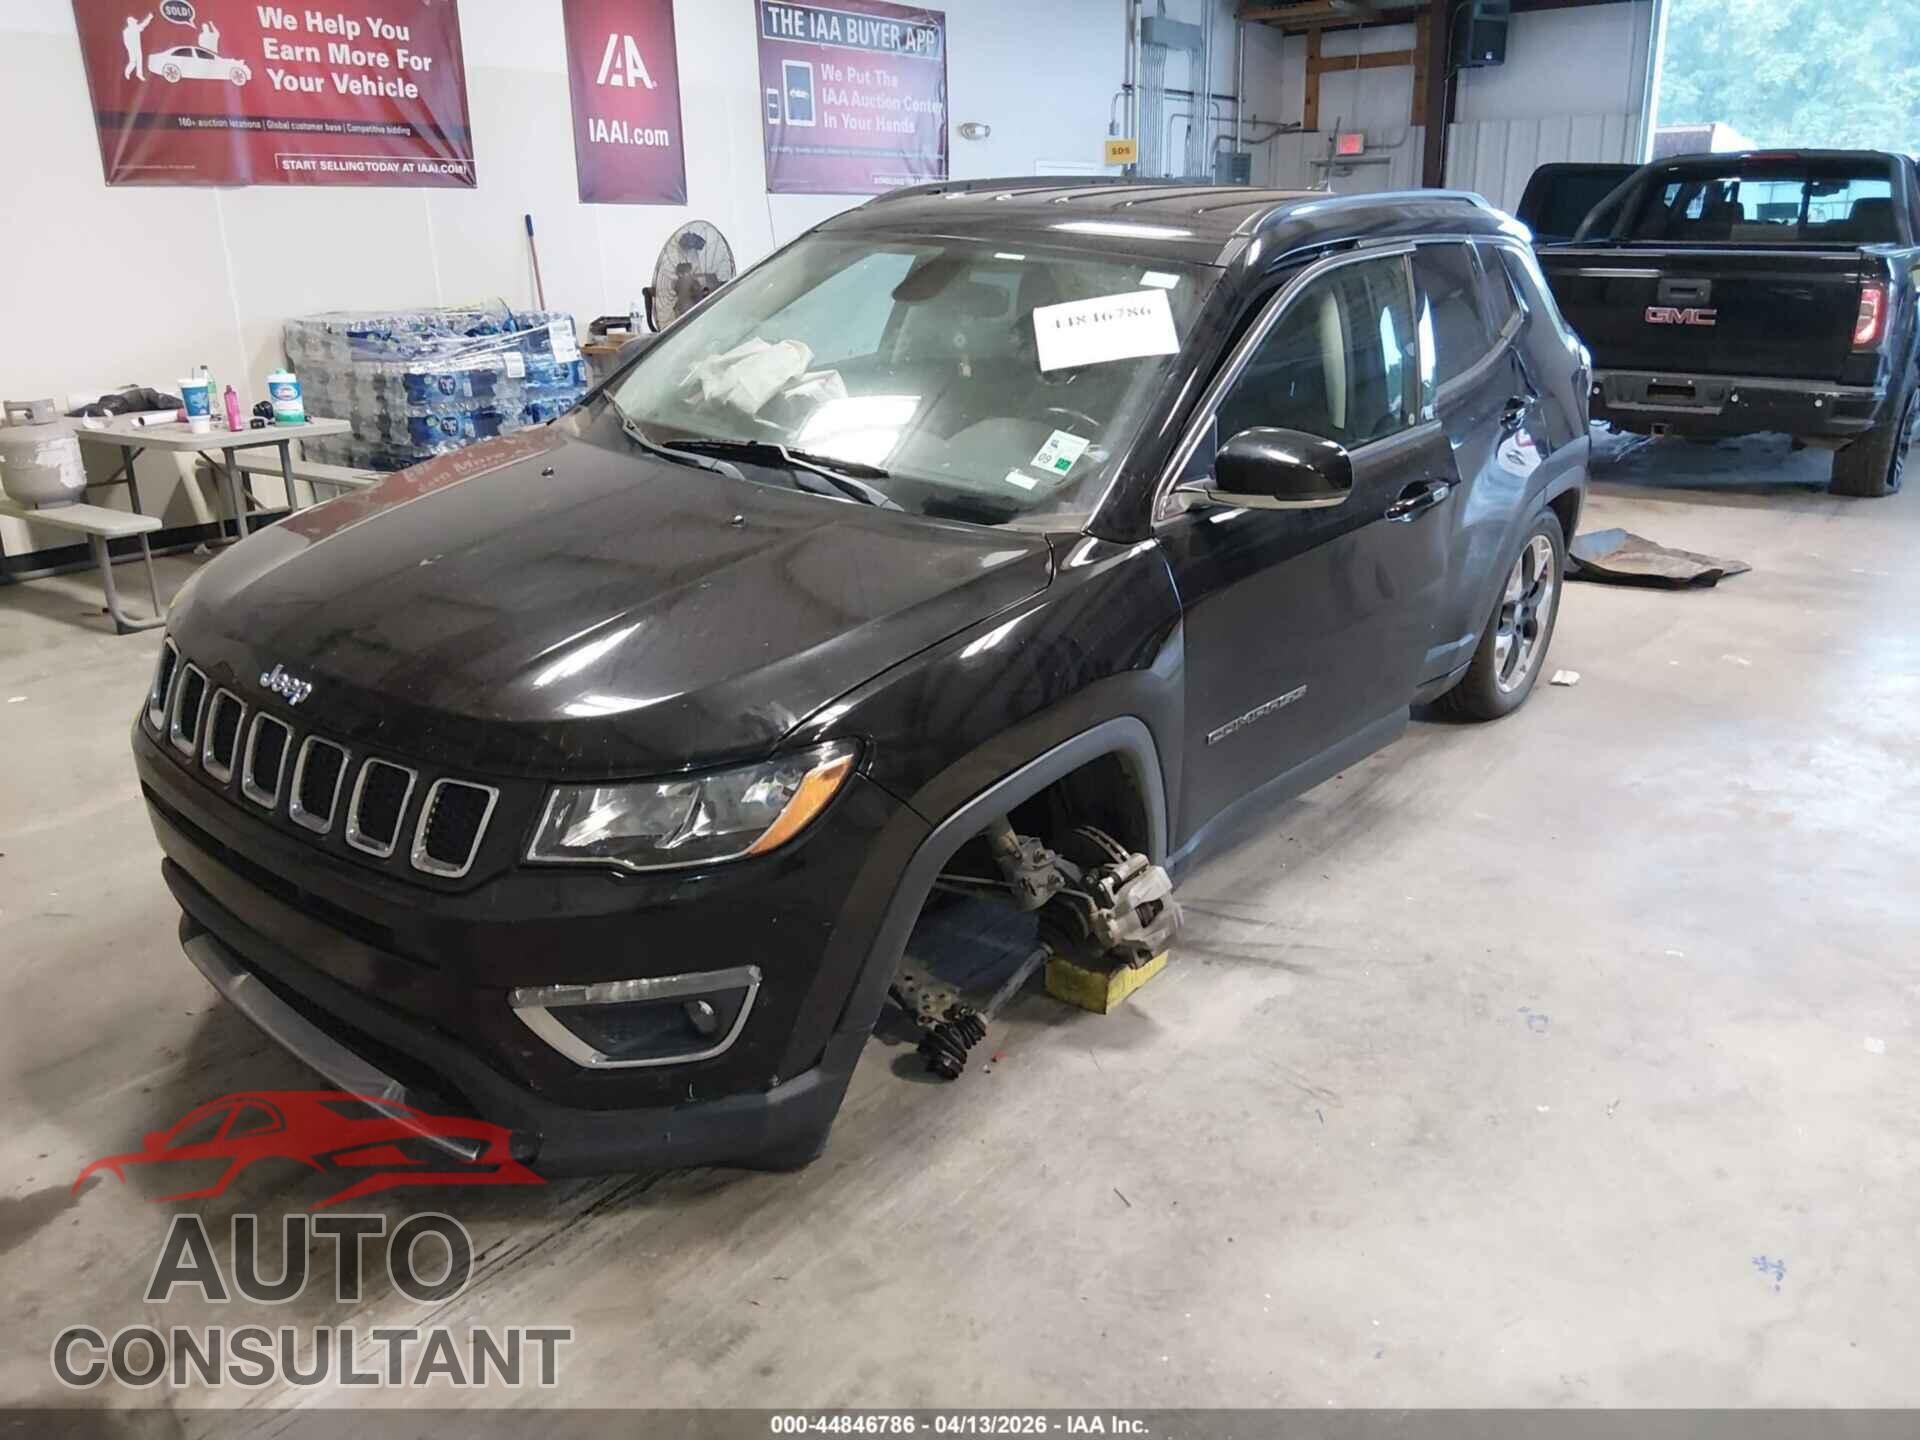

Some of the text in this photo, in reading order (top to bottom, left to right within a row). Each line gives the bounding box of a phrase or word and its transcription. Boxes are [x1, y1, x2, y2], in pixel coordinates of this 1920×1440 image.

[165, 6, 192, 17] SOLD!
[257, 6, 410, 41] We Help You
[768, 6, 936, 53] THE IAA BUYER APP
[262, 37, 433, 72] Earn More For
[266, 68, 419, 99] Your Vehicle
[821, 64, 898, 89] We Put The
[822, 87, 850, 107] IAA
[850, 88, 901, 111] Auction
[291, 121, 324, 132] customer
[588, 117, 670, 147] IAAI.com
[823, 112, 916, 134] In Your Hands
[281, 160, 318, 171] START
[319, 161, 365, 172] SELLING
[366, 161, 400, 173] TODAY
[402, 163, 416, 173] AT
[1645, 305, 1718, 327] GMC
[260, 663, 313, 706] Jeep
